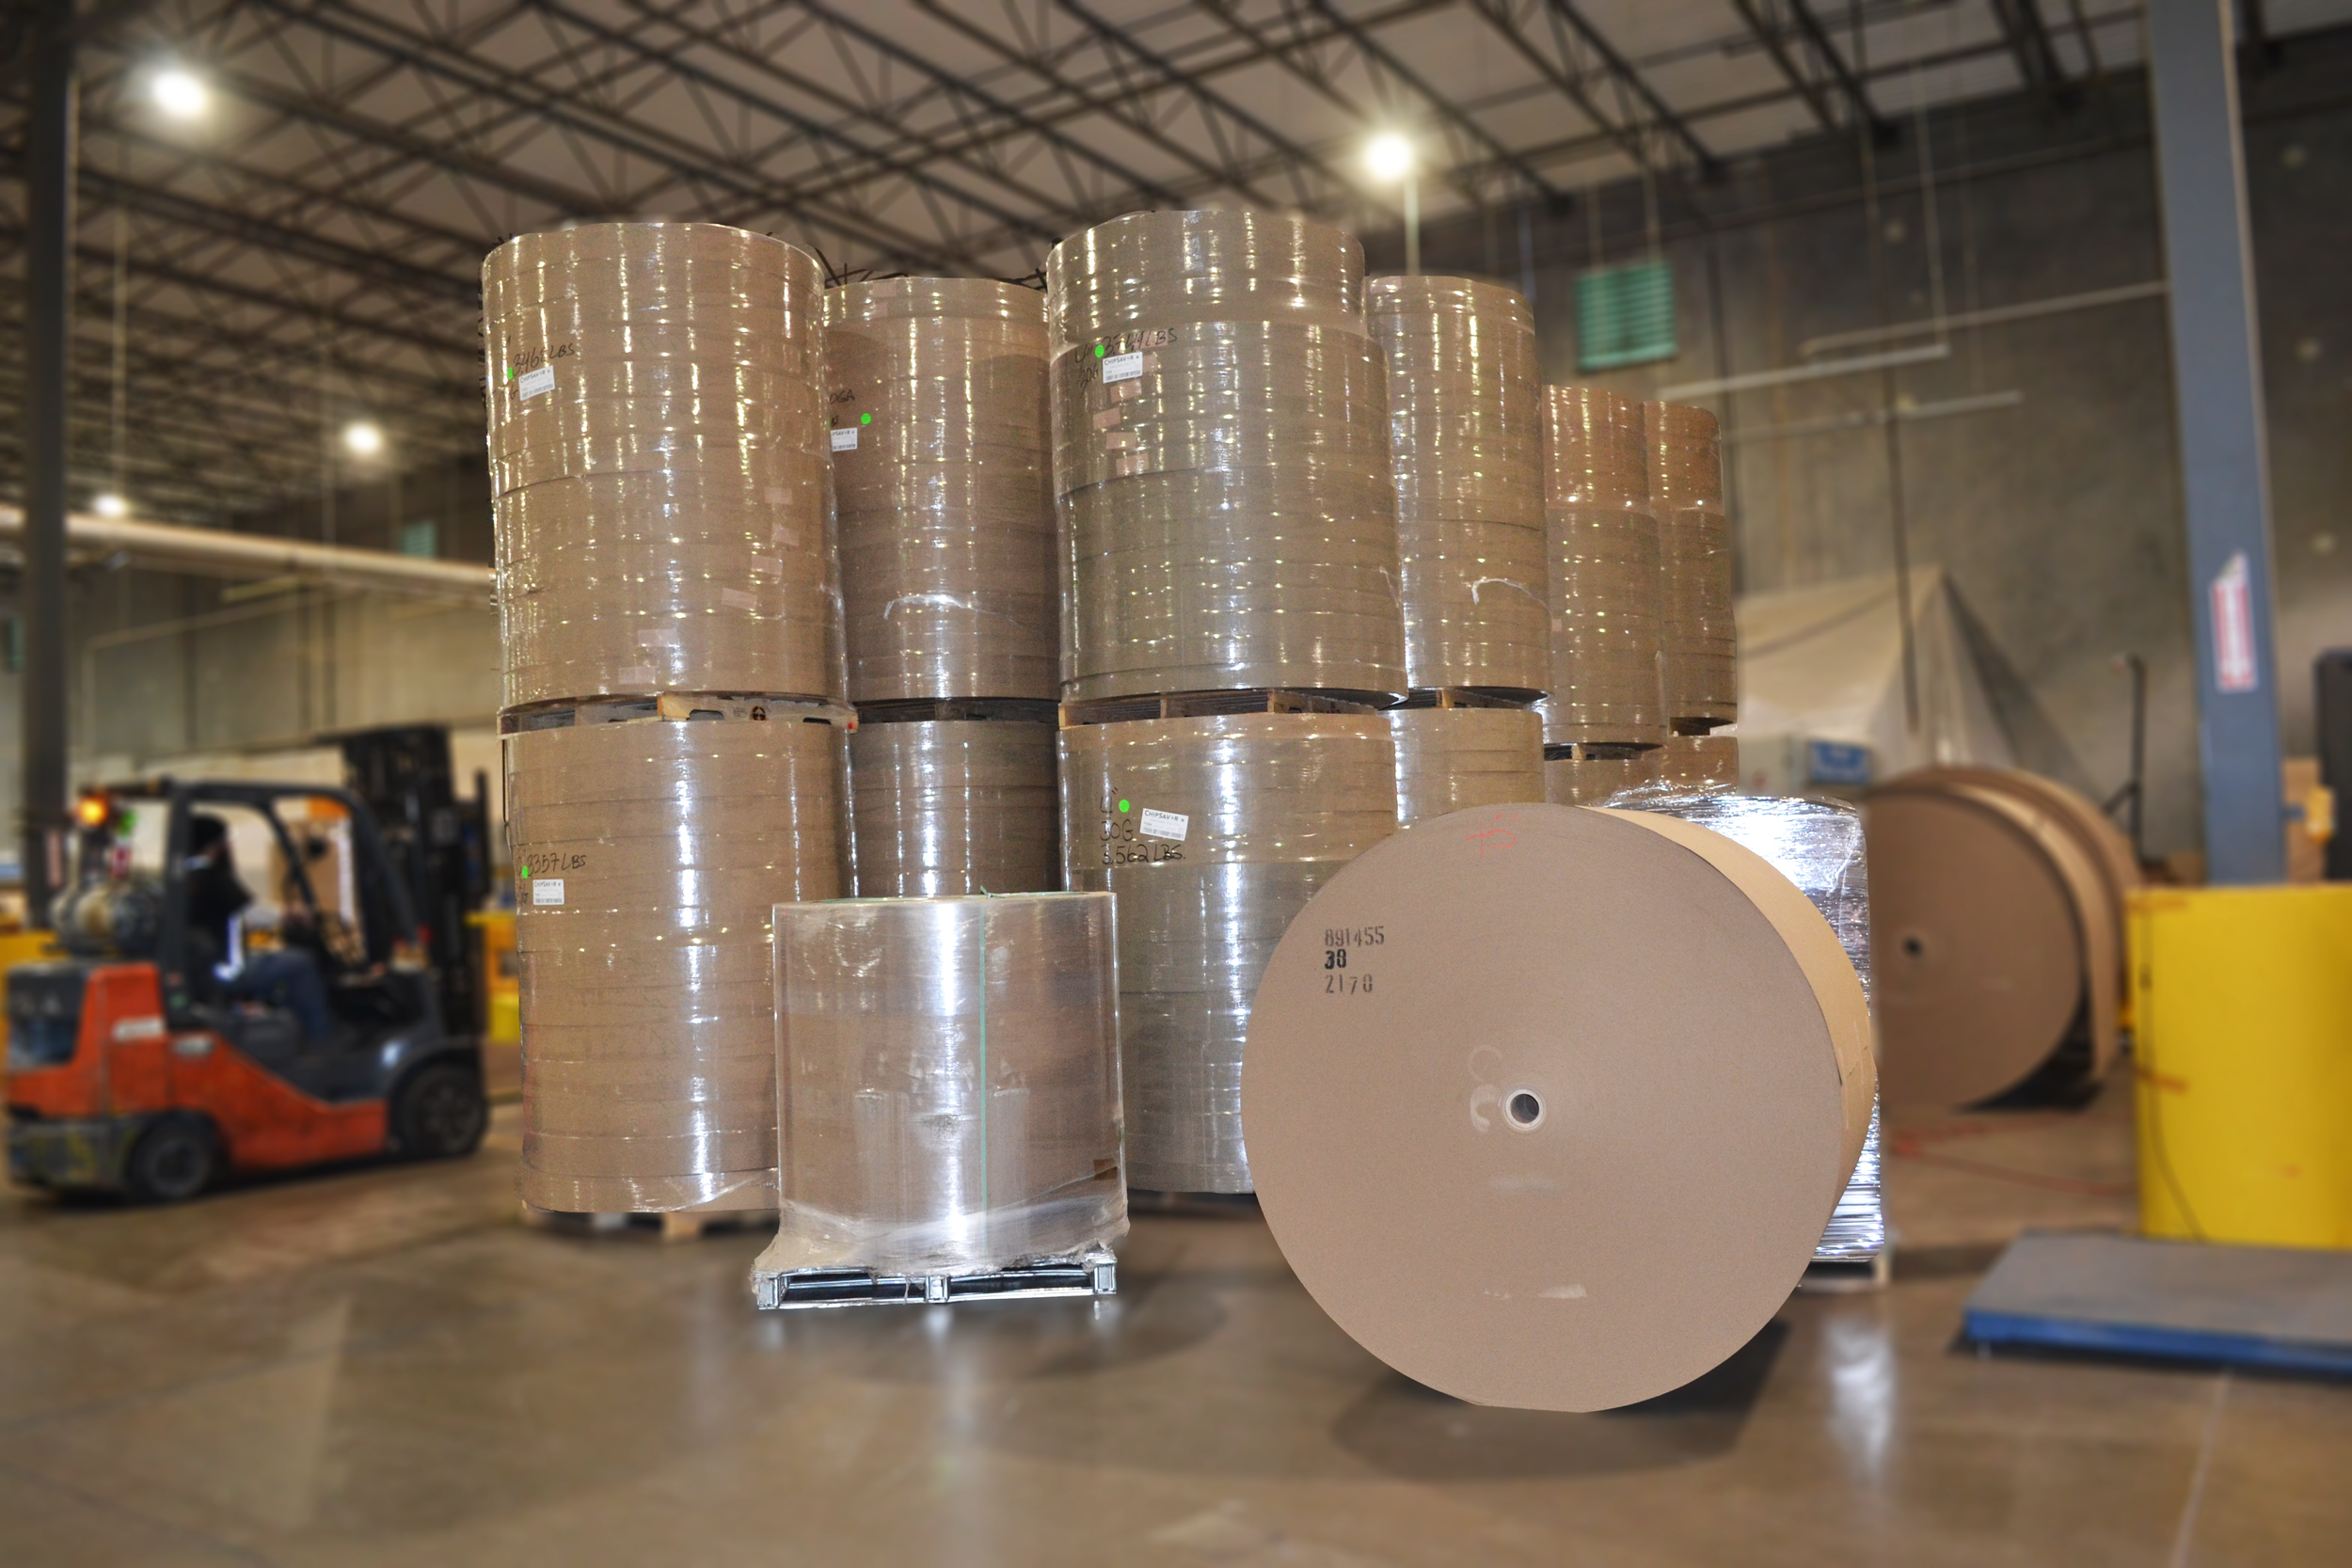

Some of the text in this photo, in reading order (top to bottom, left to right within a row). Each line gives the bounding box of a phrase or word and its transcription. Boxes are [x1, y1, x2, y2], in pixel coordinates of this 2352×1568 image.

[561, 852, 587, 871] LBS
[1324, 926, 1385, 947] 891455
[1325, 974, 1374, 995] 2170
